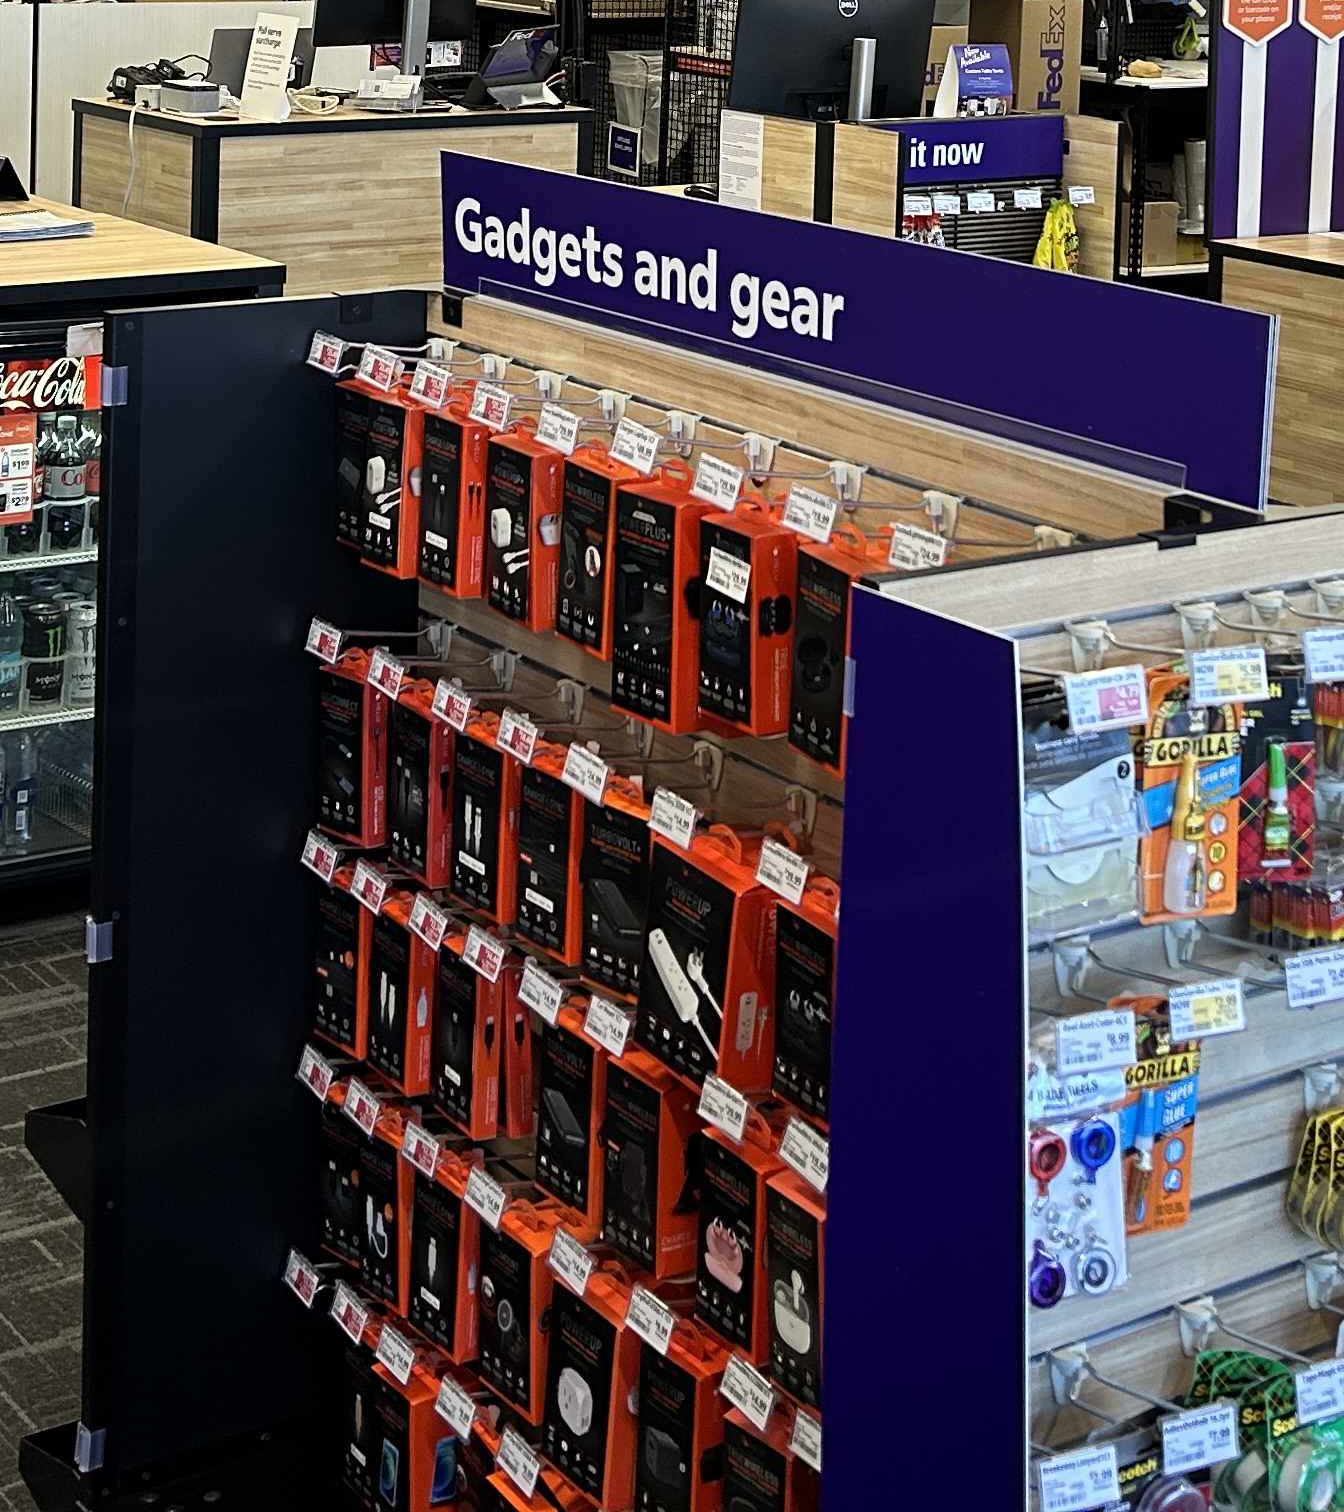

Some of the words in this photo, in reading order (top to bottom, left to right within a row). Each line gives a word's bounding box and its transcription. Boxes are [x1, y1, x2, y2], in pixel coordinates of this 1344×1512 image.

[1037, 3, 1066, 111] FedEx
[909, 138, 927, 168] it
[932, 142, 985, 168] now
[454, 195, 624, 289] Gadgets
[633, 248, 719, 313] and
[728, 272, 846, 344] gear
[61, 468, 85, 488] Co
[1155, 735, 1229, 763] GORILLA
[665, 875, 712, 915] POWERUP
[1125, 1057, 1190, 1084] GORILLA
[1163, 1085, 1194, 1105] SUPER
[1162, 1104, 1187, 1125] GLUE
[560, 1311, 603, 1351] POWERUP
[1272, 1413, 1298, 1438] Sco
[1119, 1458, 1157, 1482] cotch
